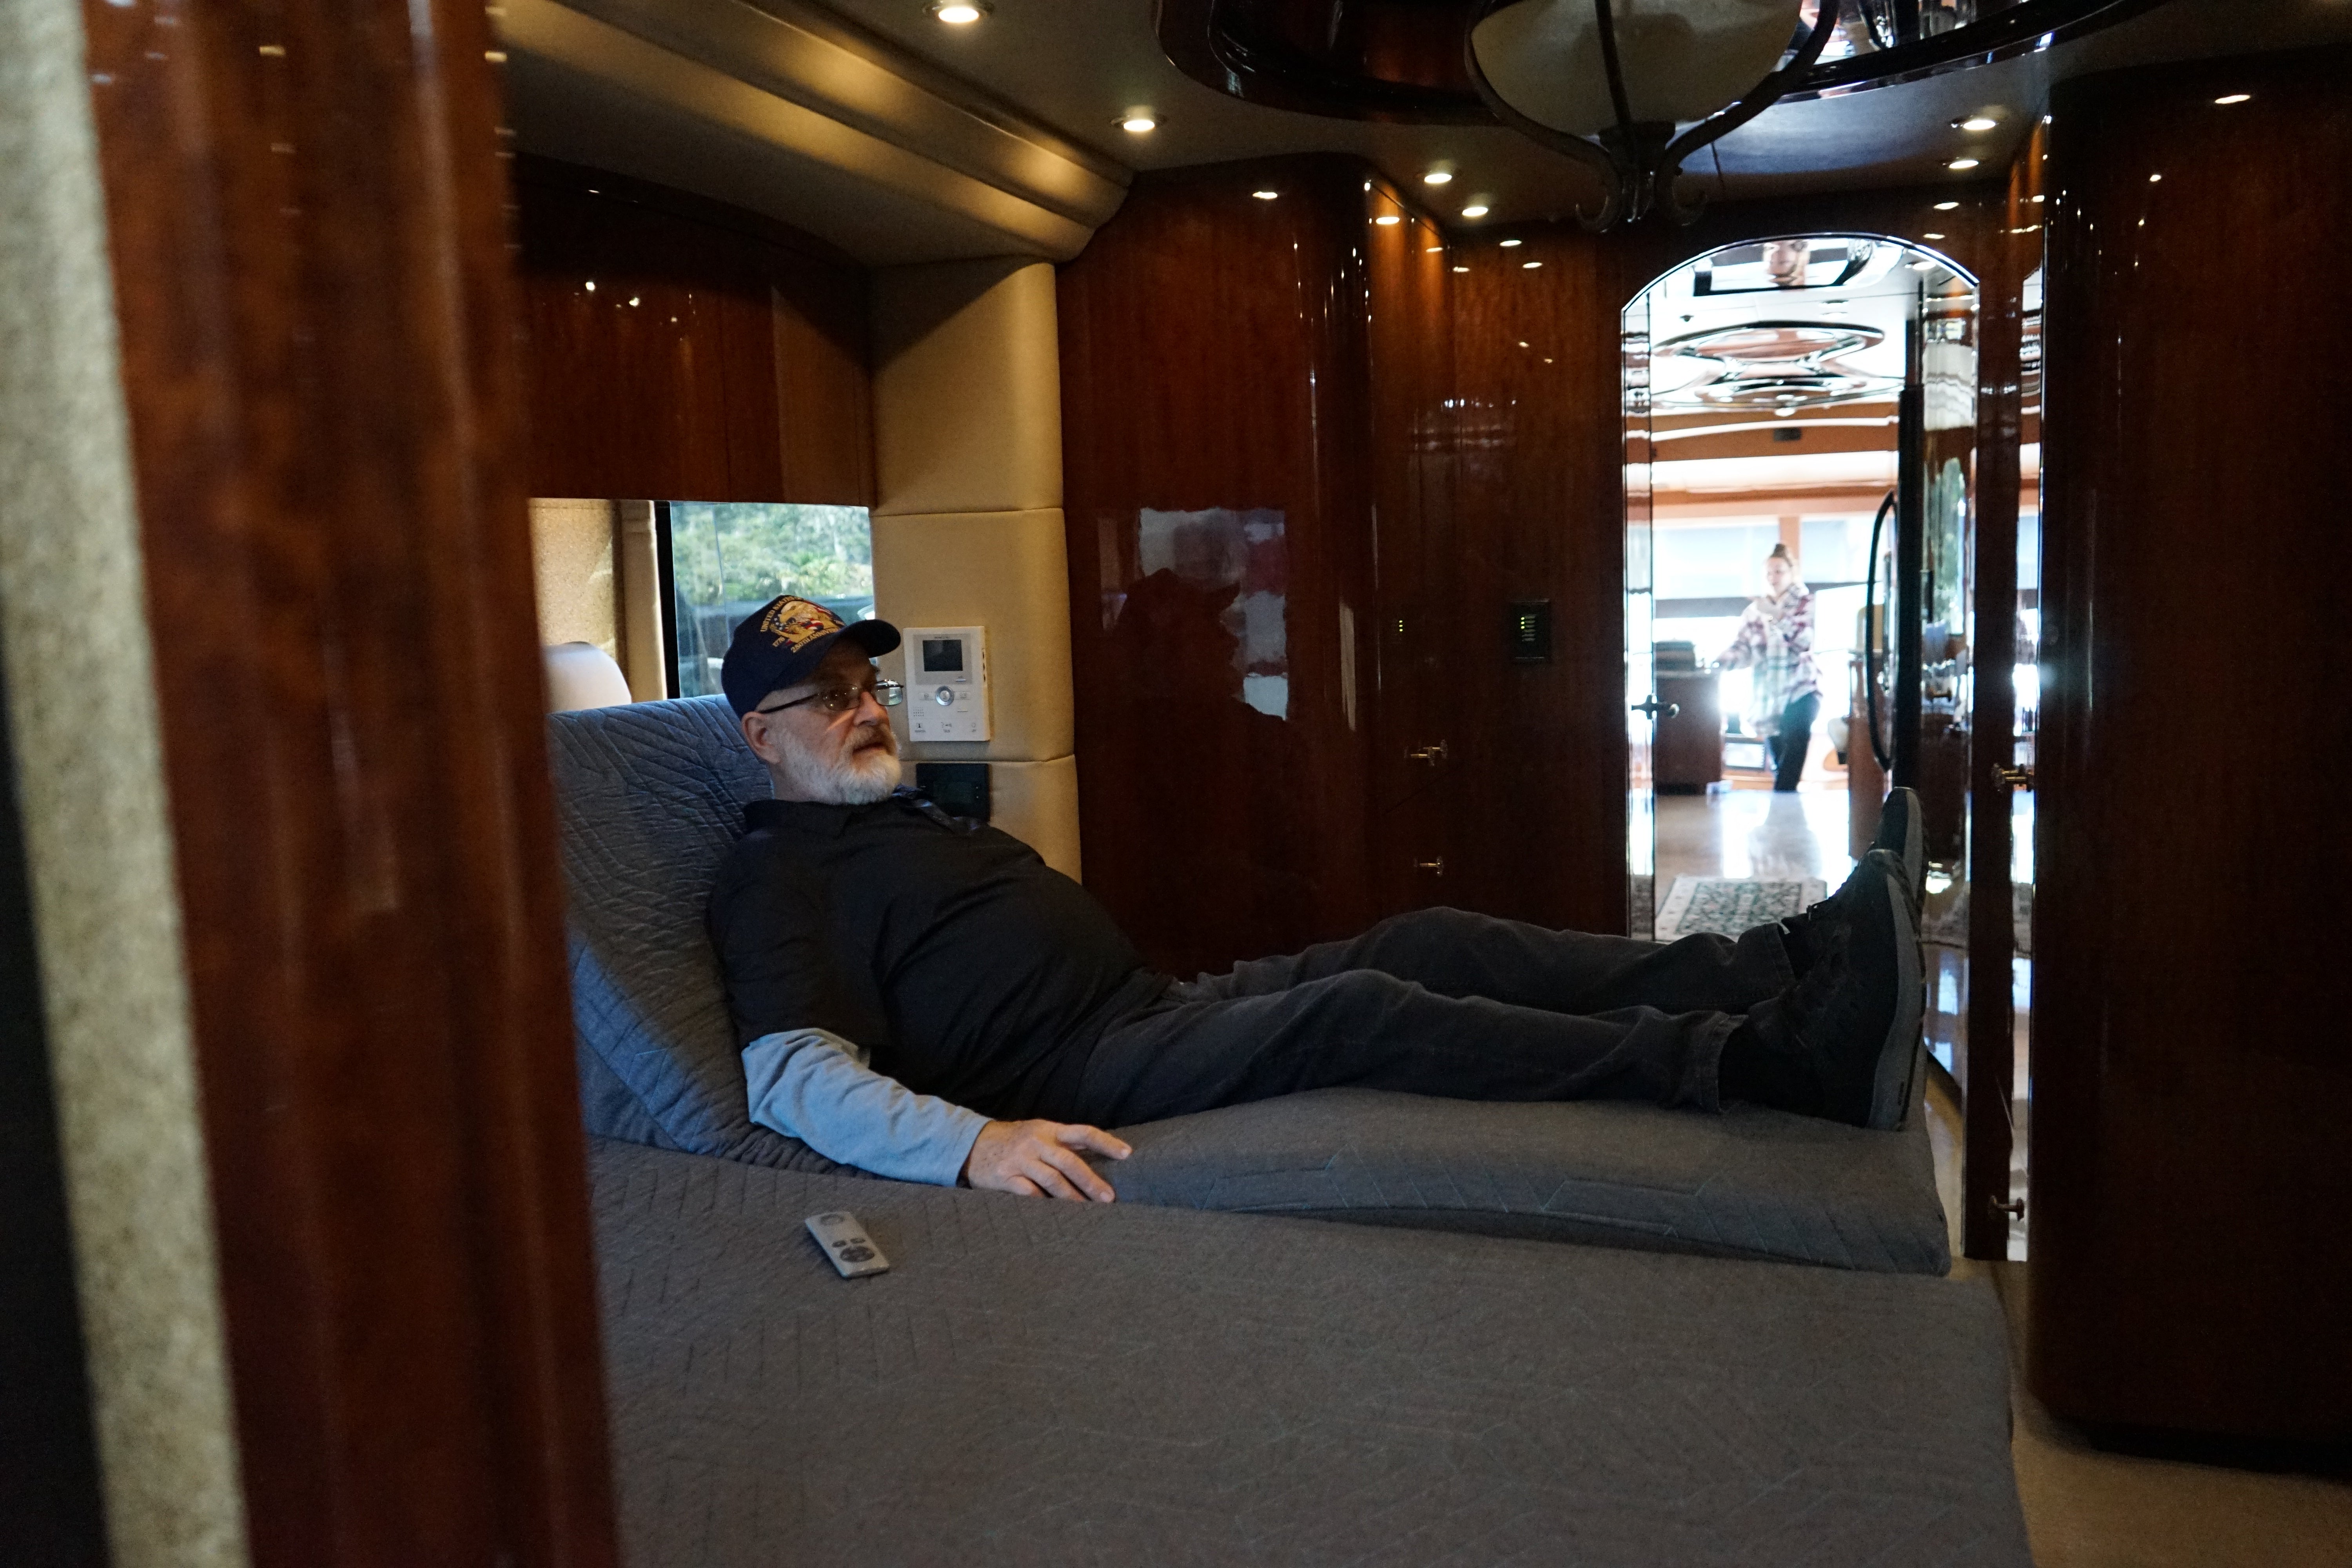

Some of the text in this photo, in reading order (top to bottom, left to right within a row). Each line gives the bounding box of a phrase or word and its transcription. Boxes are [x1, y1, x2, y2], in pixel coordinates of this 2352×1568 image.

[760, 610, 775, 632] UNITED
[772, 636, 785, 647] 1776
[791, 637, 811, 653] 250TH
